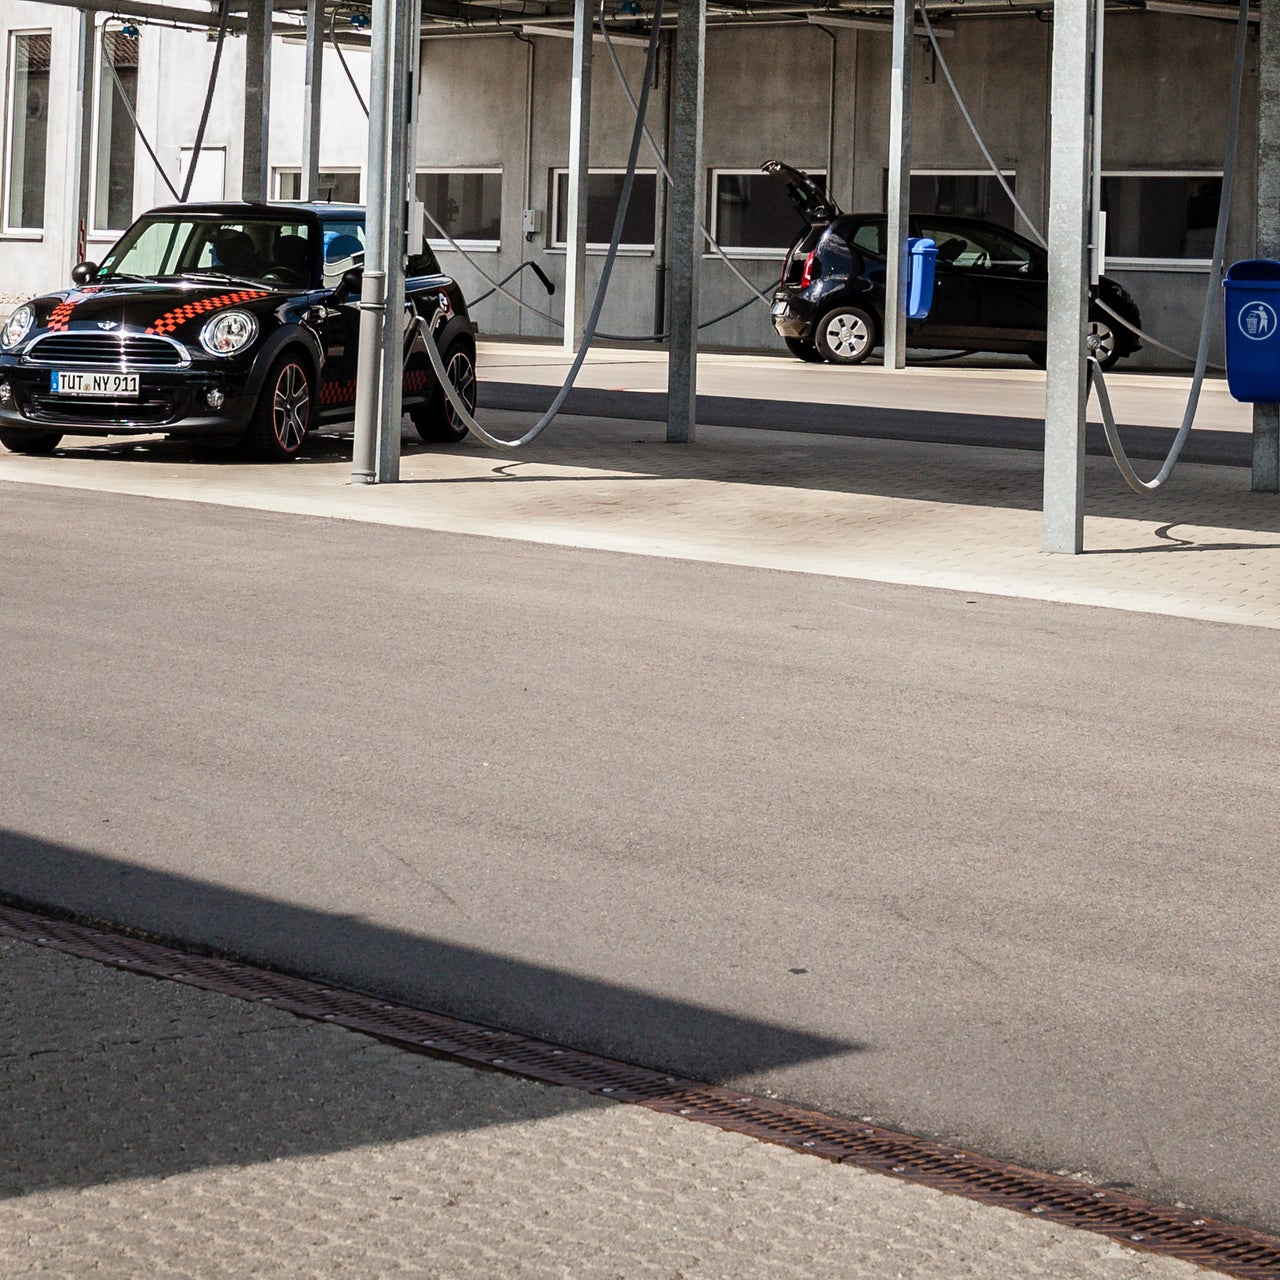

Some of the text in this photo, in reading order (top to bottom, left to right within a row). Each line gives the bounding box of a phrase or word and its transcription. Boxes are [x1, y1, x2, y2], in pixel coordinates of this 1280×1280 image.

[60, 374, 138, 392] TUT NY 911
